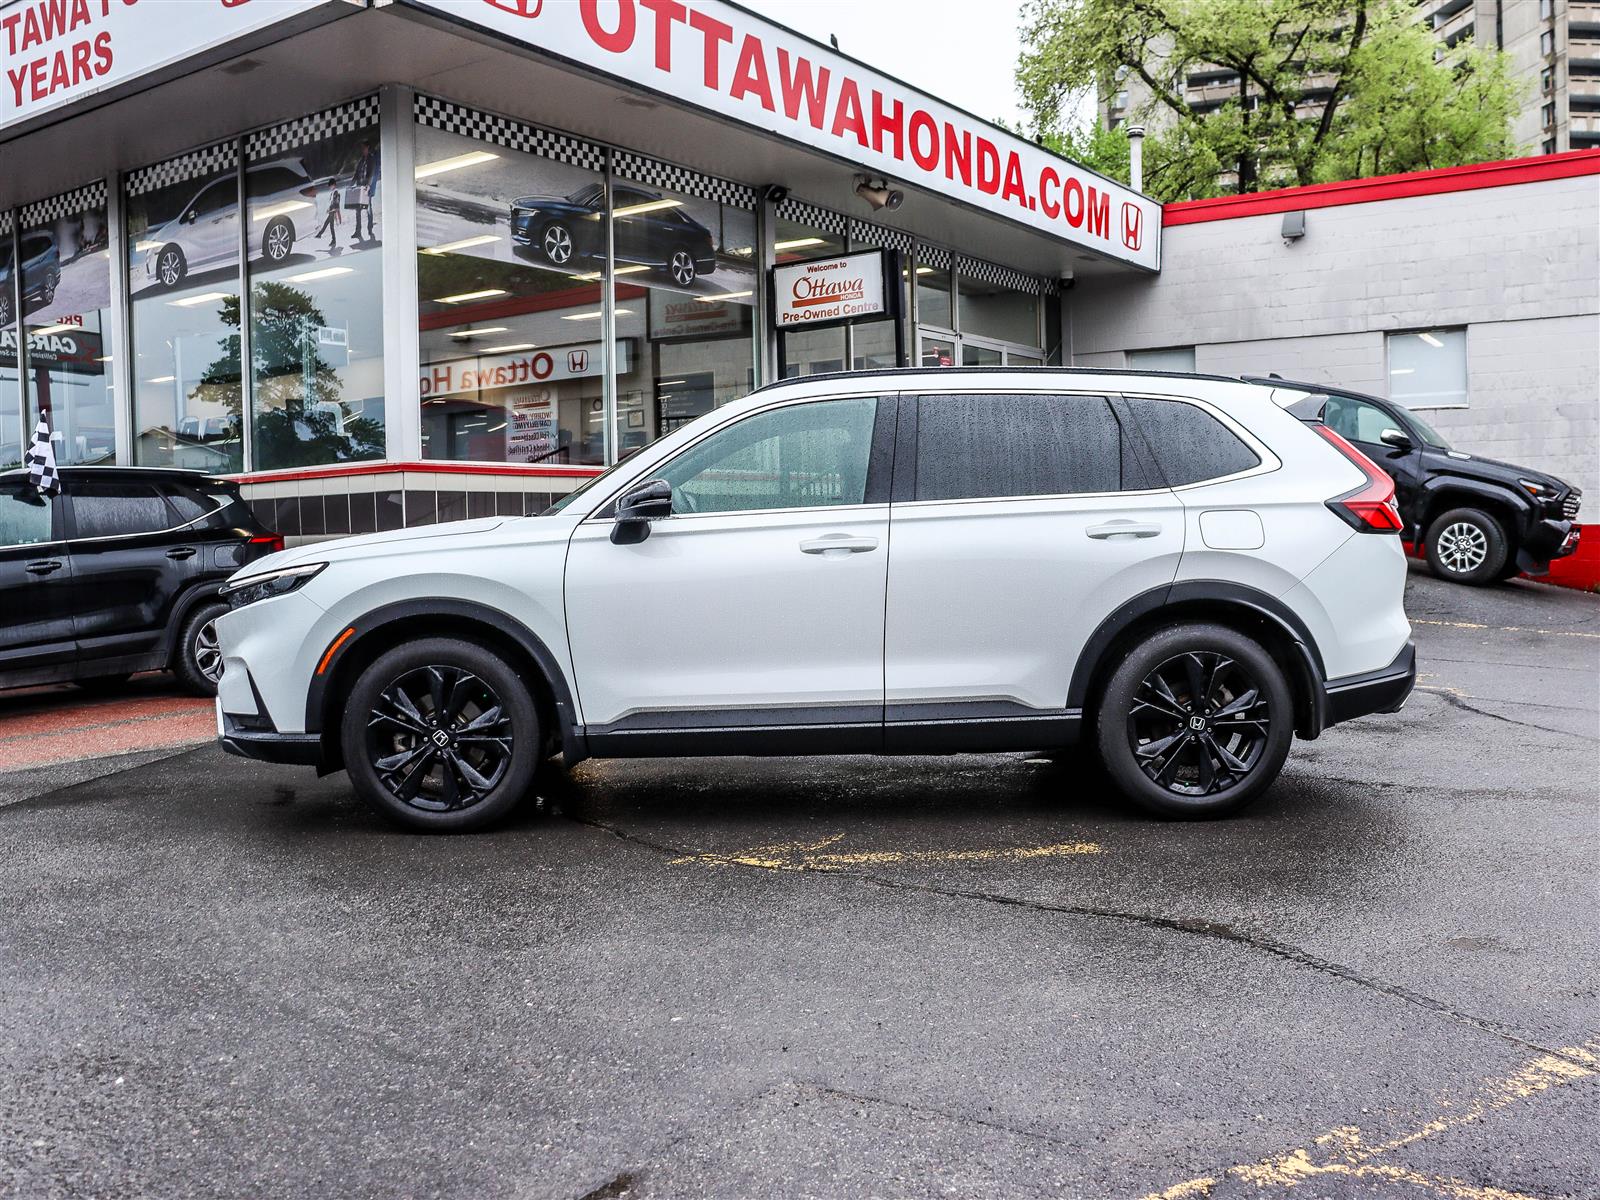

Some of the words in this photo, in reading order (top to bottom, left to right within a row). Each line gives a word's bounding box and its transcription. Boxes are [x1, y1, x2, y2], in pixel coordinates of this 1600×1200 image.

[0, 0, 91, 56] TAWA
[7, 31, 113, 107] YEARS
[580, 0, 1110, 240] OTTAWAHONDA.COM
[807, 263, 838, 273] Welcome
[793, 276, 863, 299] Ottawa
[840, 293, 862, 301] HONDA
[783, 306, 840, 323] Pre-Owned
[843, 302, 879, 314] Centre
